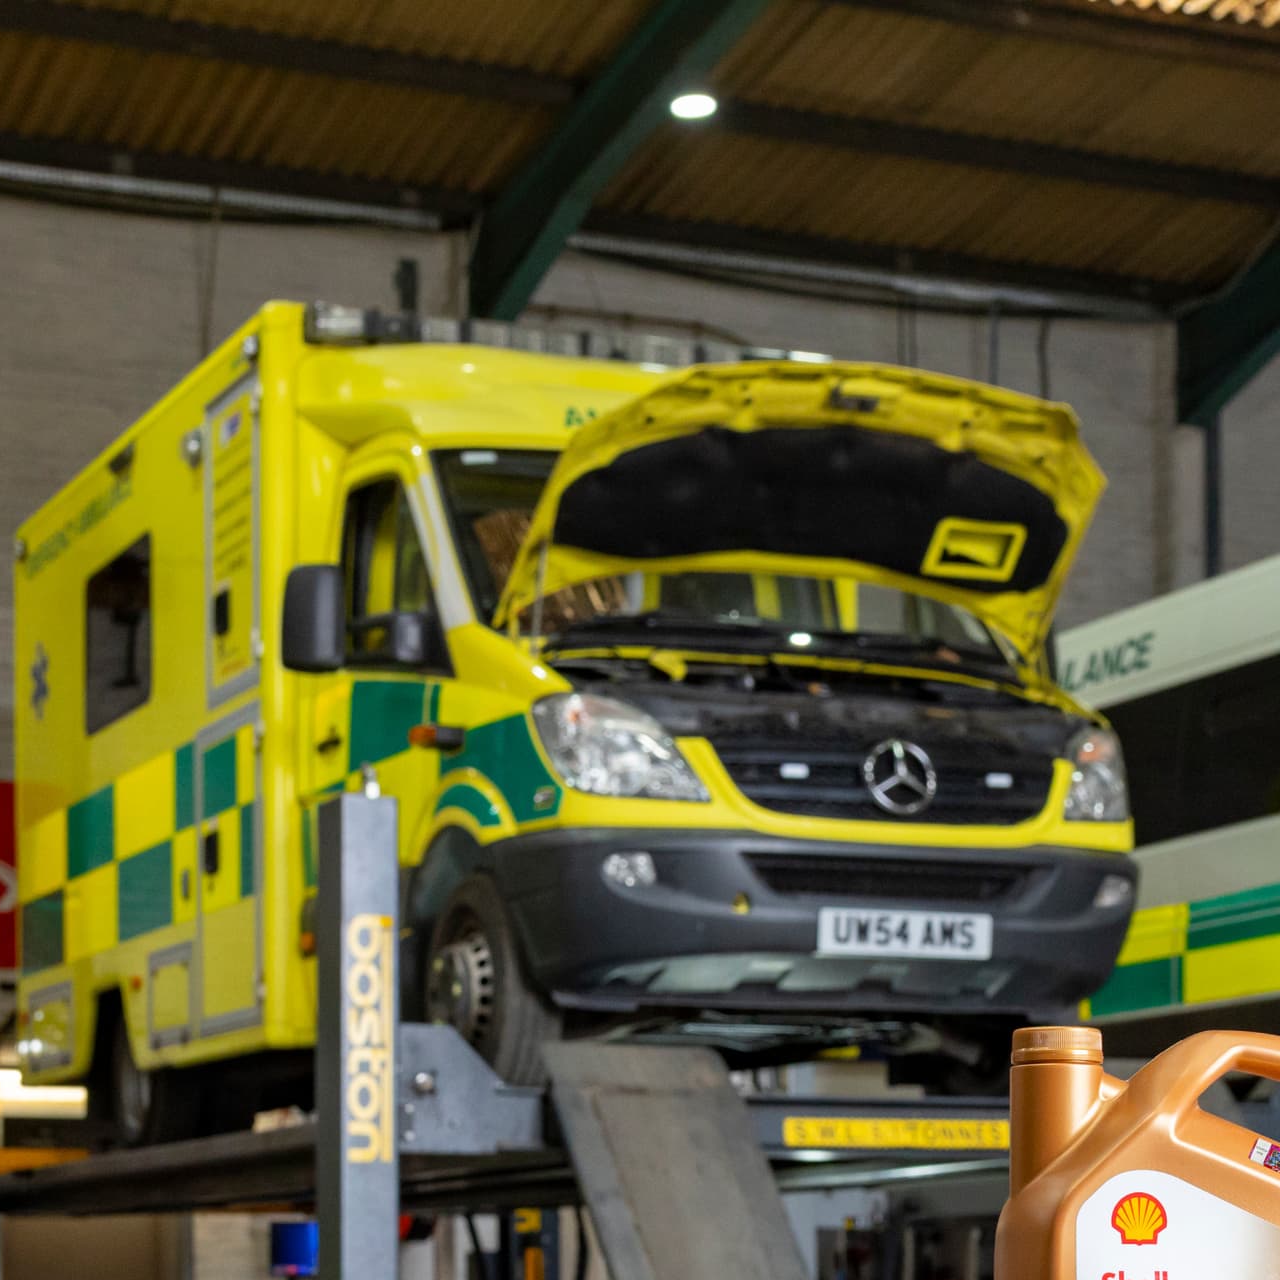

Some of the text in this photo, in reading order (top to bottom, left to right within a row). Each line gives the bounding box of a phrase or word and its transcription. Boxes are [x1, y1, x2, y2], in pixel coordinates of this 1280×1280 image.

[833, 915, 976, 949] UW54 AMS
[348, 914, 394, 1164] boston
